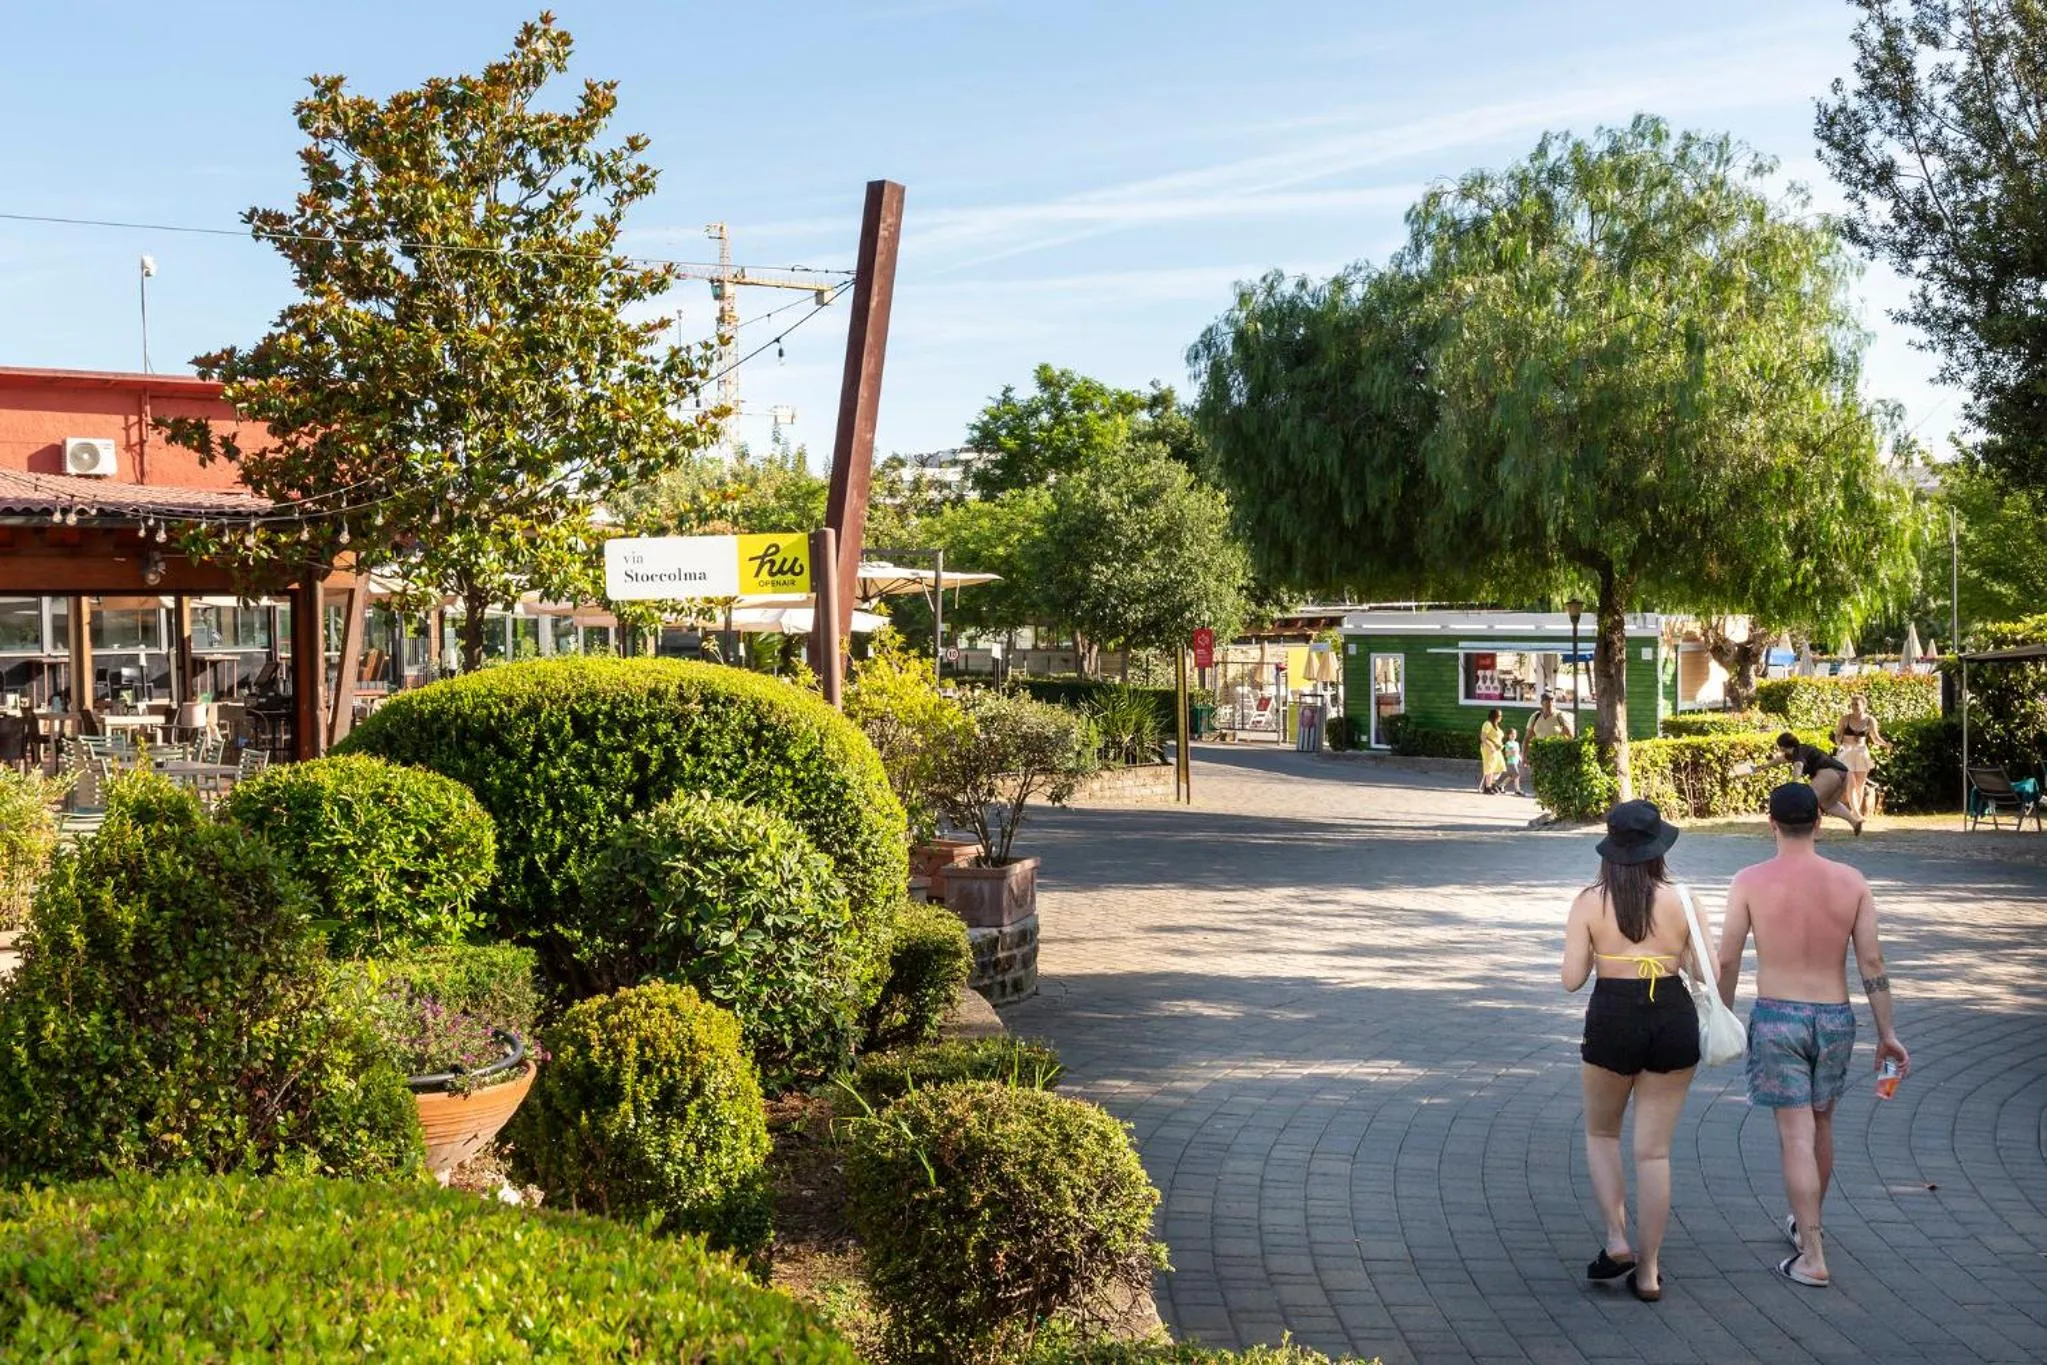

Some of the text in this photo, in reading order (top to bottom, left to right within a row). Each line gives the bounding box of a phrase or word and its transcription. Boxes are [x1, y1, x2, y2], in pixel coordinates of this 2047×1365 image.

[623, 551, 644, 564] via
[624, 567, 708, 583] Stoccolma
[758, 579, 797, 588] OPENAIR
